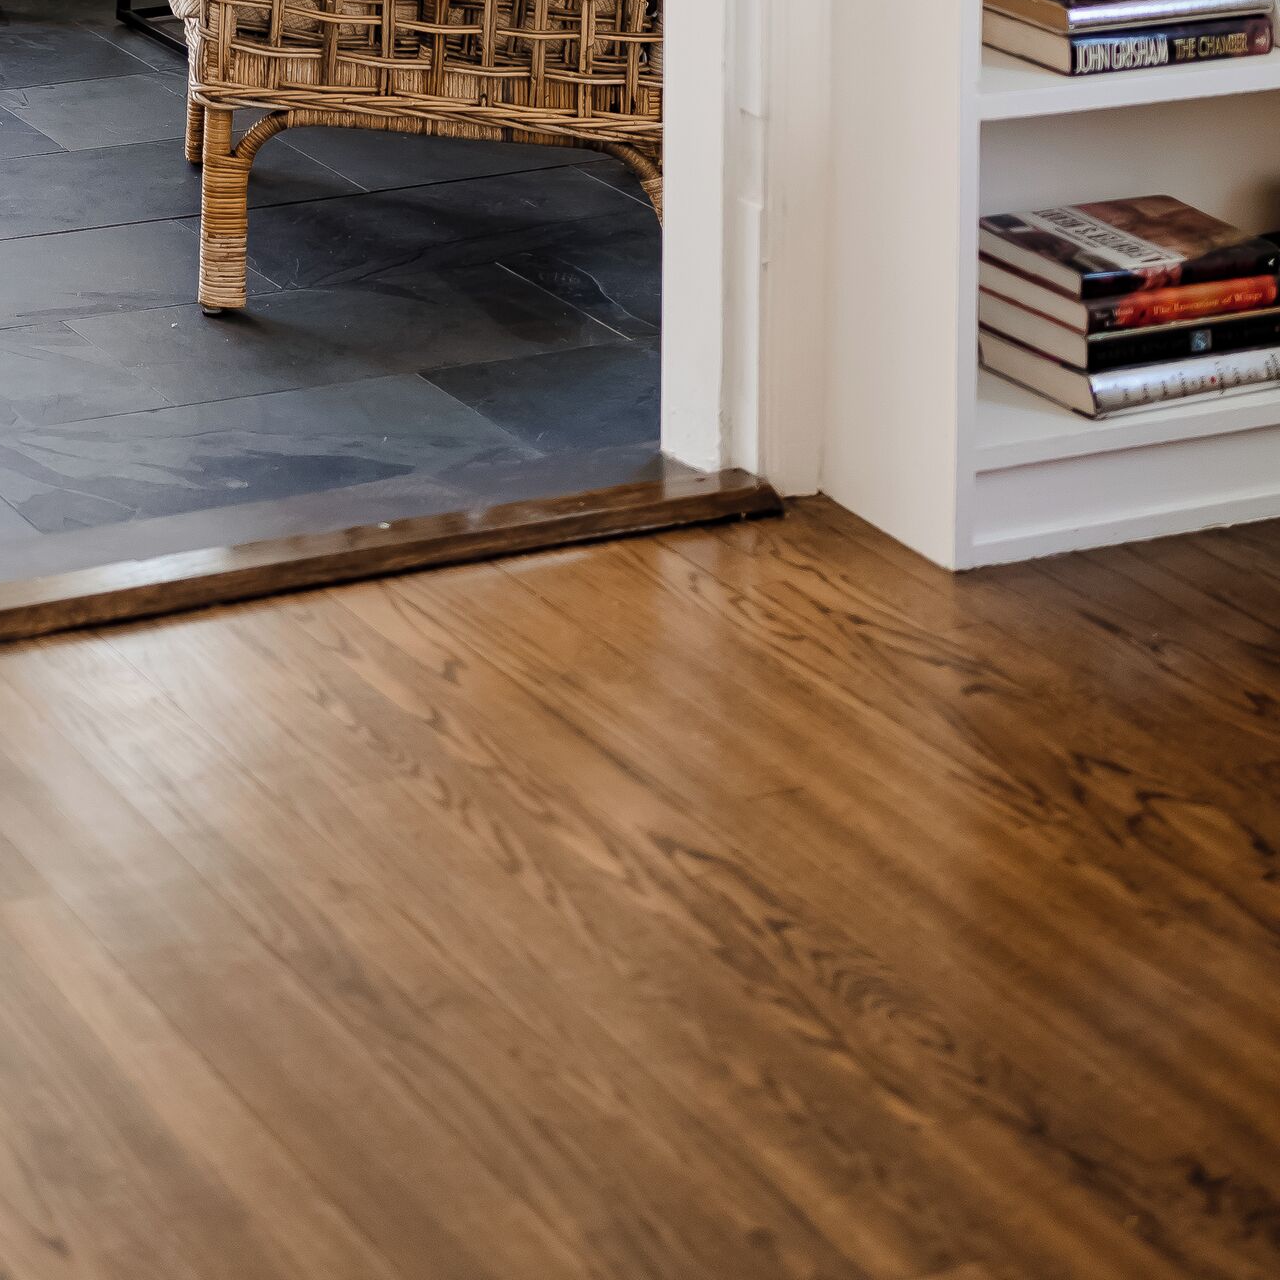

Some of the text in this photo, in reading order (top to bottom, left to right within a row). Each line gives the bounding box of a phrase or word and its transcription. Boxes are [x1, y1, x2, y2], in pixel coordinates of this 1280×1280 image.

[1075, 32, 1169, 74] JOHN GRISHAM
[1174, 38, 1197, 60] THE
